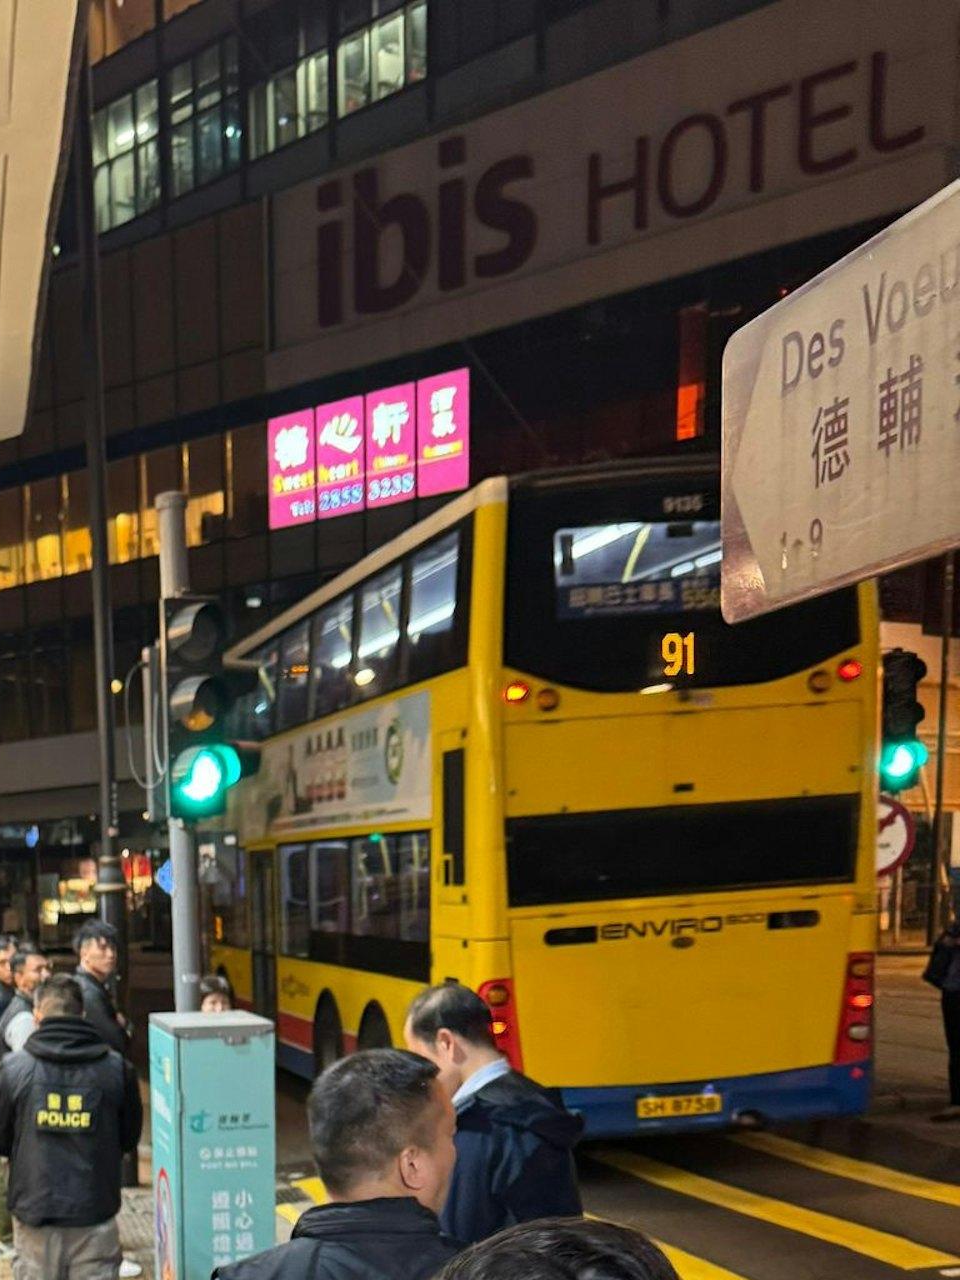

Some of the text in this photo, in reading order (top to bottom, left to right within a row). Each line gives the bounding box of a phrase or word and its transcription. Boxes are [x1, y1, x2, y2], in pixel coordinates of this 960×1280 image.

[317, 51, 927, 329] ibis HOTEL
[781, 317, 846, 398] Des
[811, 335, 960, 491] 德輔
[661, 632, 695, 676] 91
[37, 1109, 91, 1128] POLICE
